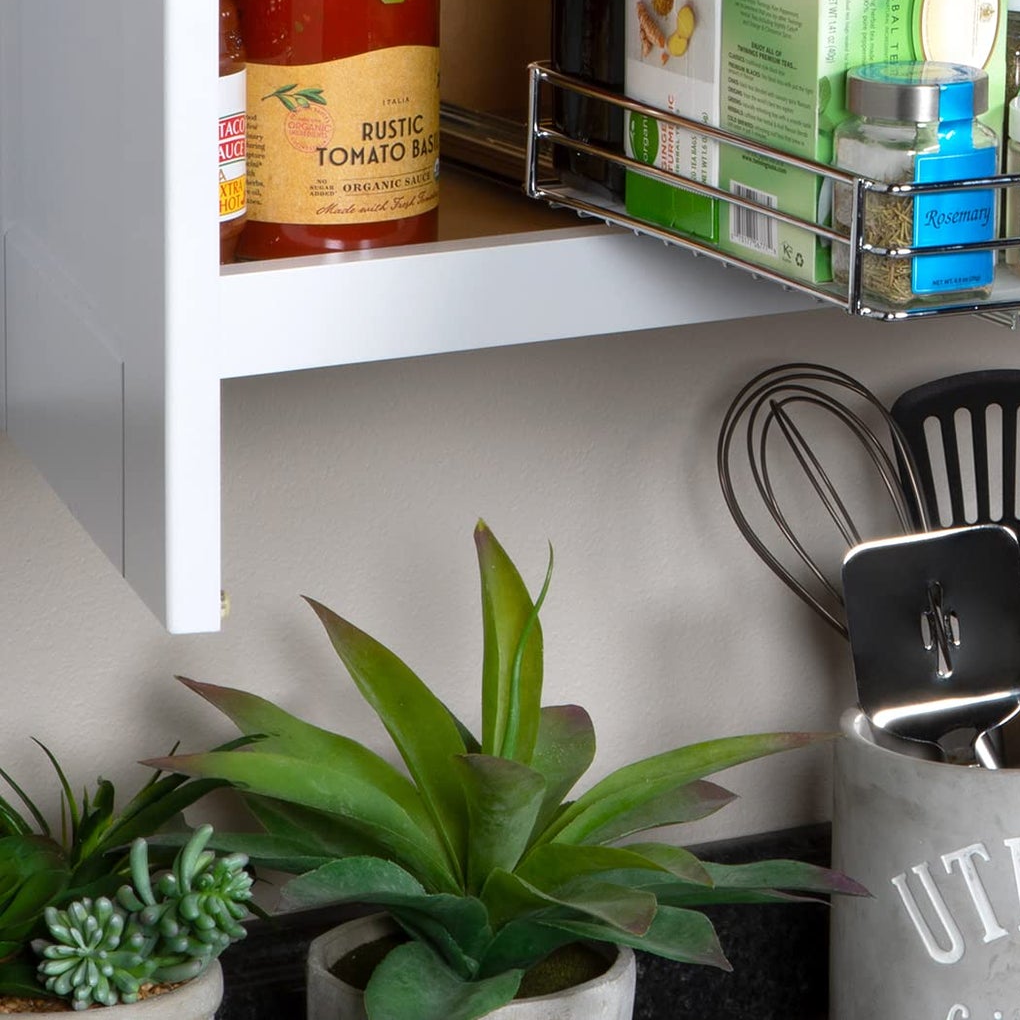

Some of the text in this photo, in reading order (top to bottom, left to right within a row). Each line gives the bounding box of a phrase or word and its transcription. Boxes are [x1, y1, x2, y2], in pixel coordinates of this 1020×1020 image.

[382, 96, 410, 106] ITALIA
[219, 117, 246, 138] TACO
[362, 114, 424, 141] RUSTIC
[316, 142, 406, 166] TOMATO
[343, 172, 431, 192] ORGANIC SAUCE
[316, 196, 415, 216] Made with Fresh
[924, 206, 991, 230] Rosemary
